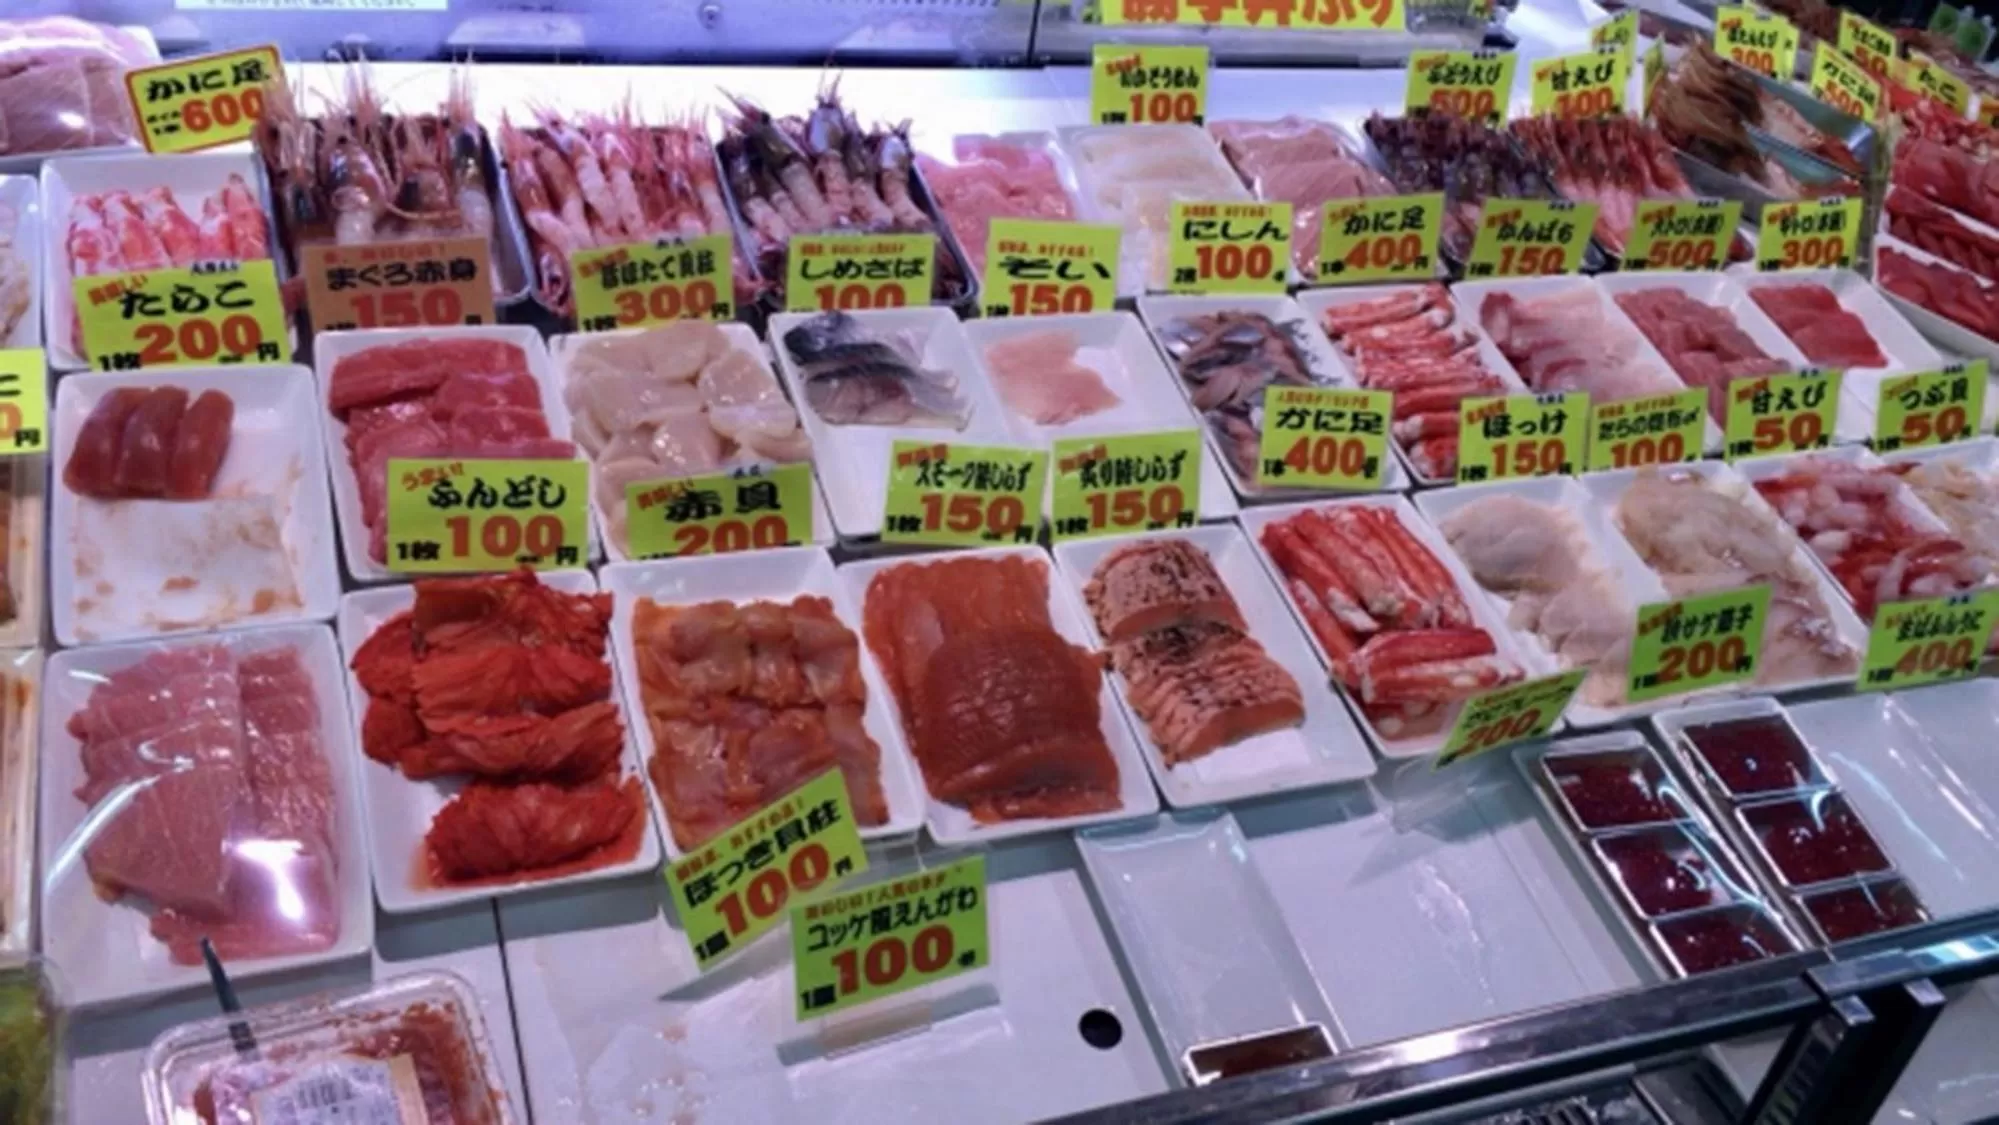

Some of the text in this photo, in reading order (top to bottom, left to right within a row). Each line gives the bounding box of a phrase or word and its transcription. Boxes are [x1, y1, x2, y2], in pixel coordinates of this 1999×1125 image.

[146, 60, 268, 102] かに足
[182, 88, 265, 133] 600
[1129, 93, 1197, 122] 100
[1183, 219, 1288, 242] にしん
[1343, 205, 1426, 236] かに足
[800, 256, 926, 281] しめさば
[1196, 244, 1274, 279] 100
[1343, 235, 1423, 272] 400
[1498, 247, 1566, 275] 150
[1648, 240, 1717, 268] 500
[1781, 237, 1843, 268] 300
[327, 259, 476, 290] まぐろ赤身
[352, 288, 462, 326] 150
[613, 281, 717, 326] 300
[815, 283, 907, 310] 100
[1009, 283, 1093, 315] 150
[134, 315, 260, 365] 200
[257, 342, 280, 361] 円
[1751, 379, 1827, 415] 甘えび
[1275, 409, 1385, 436] かに足
[1483, 410, 1567, 438] ほっけ
[1753, 412, 1823, 450] 50
[1902, 407, 1965, 446] 50
[1284, 436, 1366, 477] 400
[1491, 438, 1567, 478] 150
[1609, 433, 1685, 468] 100
[427, 475, 566, 509] ふんどし
[1085, 485, 1185, 529] 150
[920, 494, 1025, 534] 150
[446, 515, 564, 558] 100
[555, 545, 578, 565] 円
[673, 516, 788, 559] 200
[1657, 636, 1747, 684] 200
[1896, 638, 1974, 678] 400
[1461, 708, 1542, 756] 200
[715, 843, 830, 938] 100
[831, 924, 954, 995] 100
